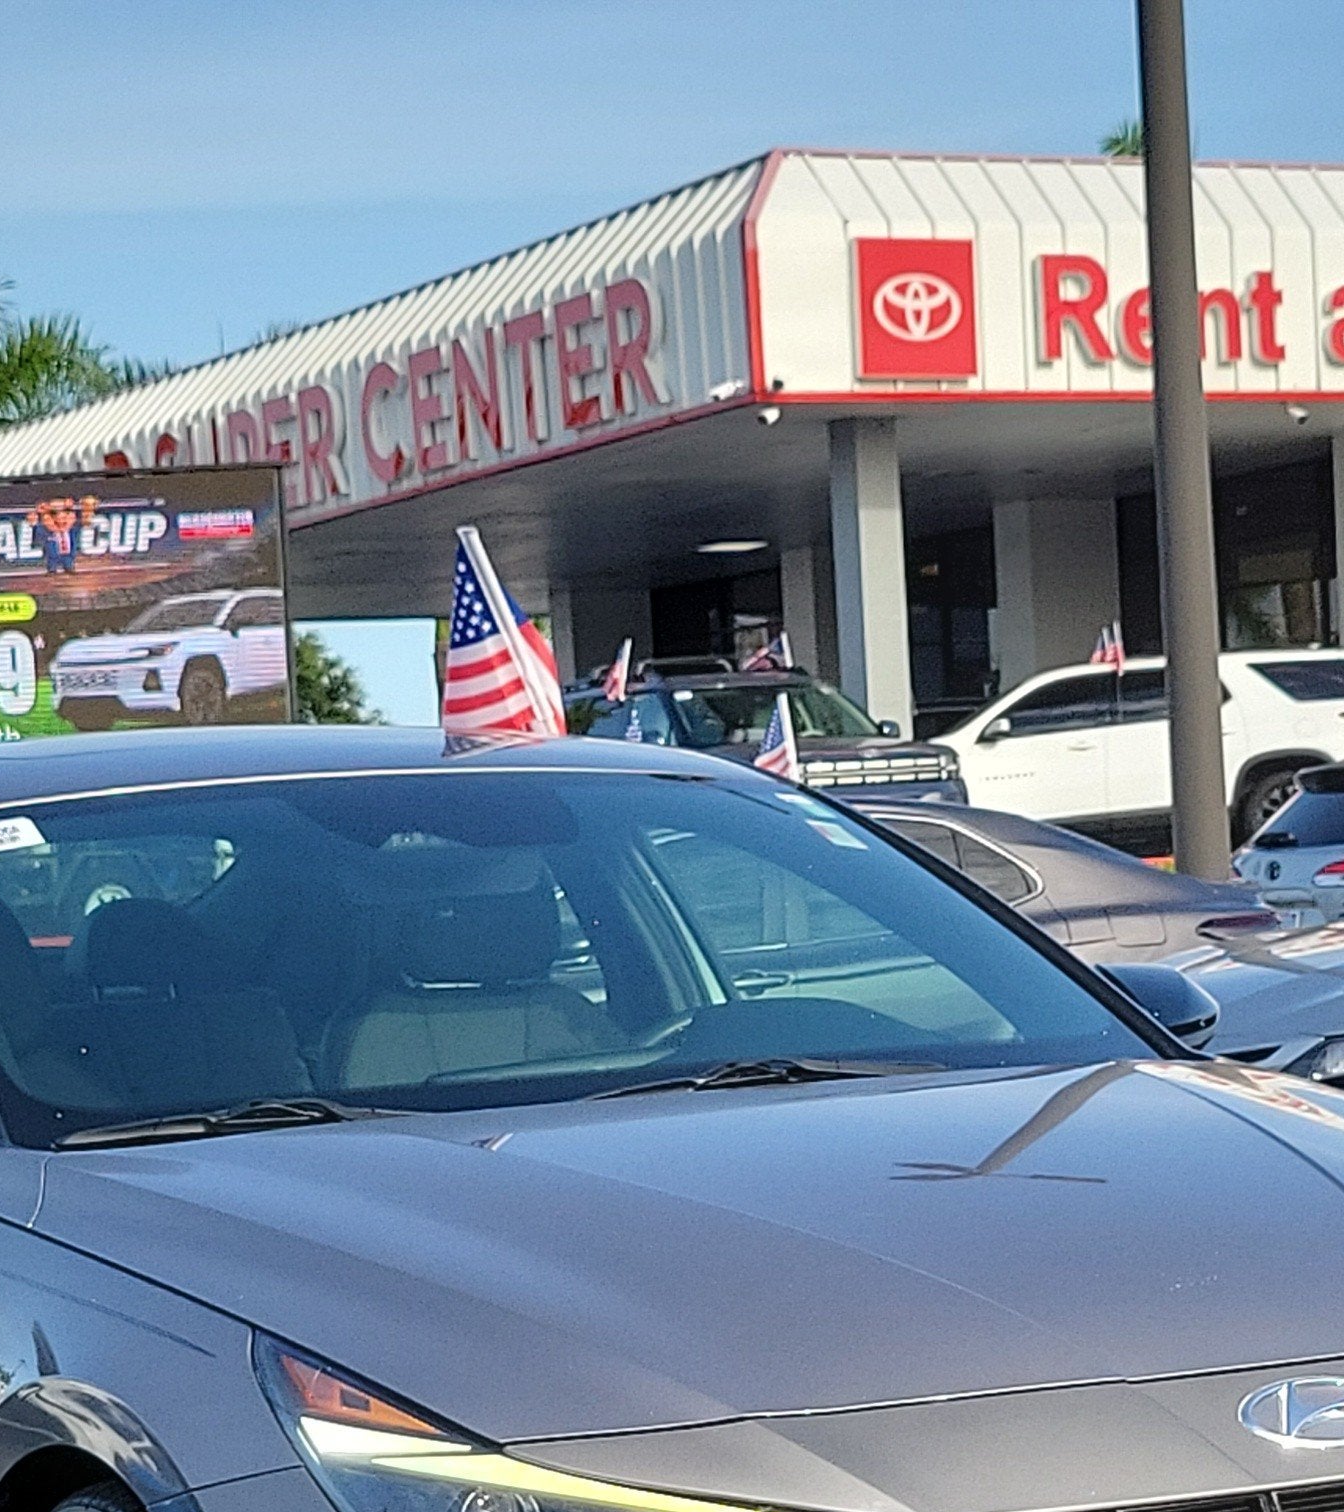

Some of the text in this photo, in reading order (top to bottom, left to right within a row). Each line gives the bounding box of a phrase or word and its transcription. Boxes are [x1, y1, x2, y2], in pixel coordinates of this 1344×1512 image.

[1036, 254, 1286, 366] Rent
[362, 278, 660, 484] CENTER
[79, 511, 168, 554] CUP
